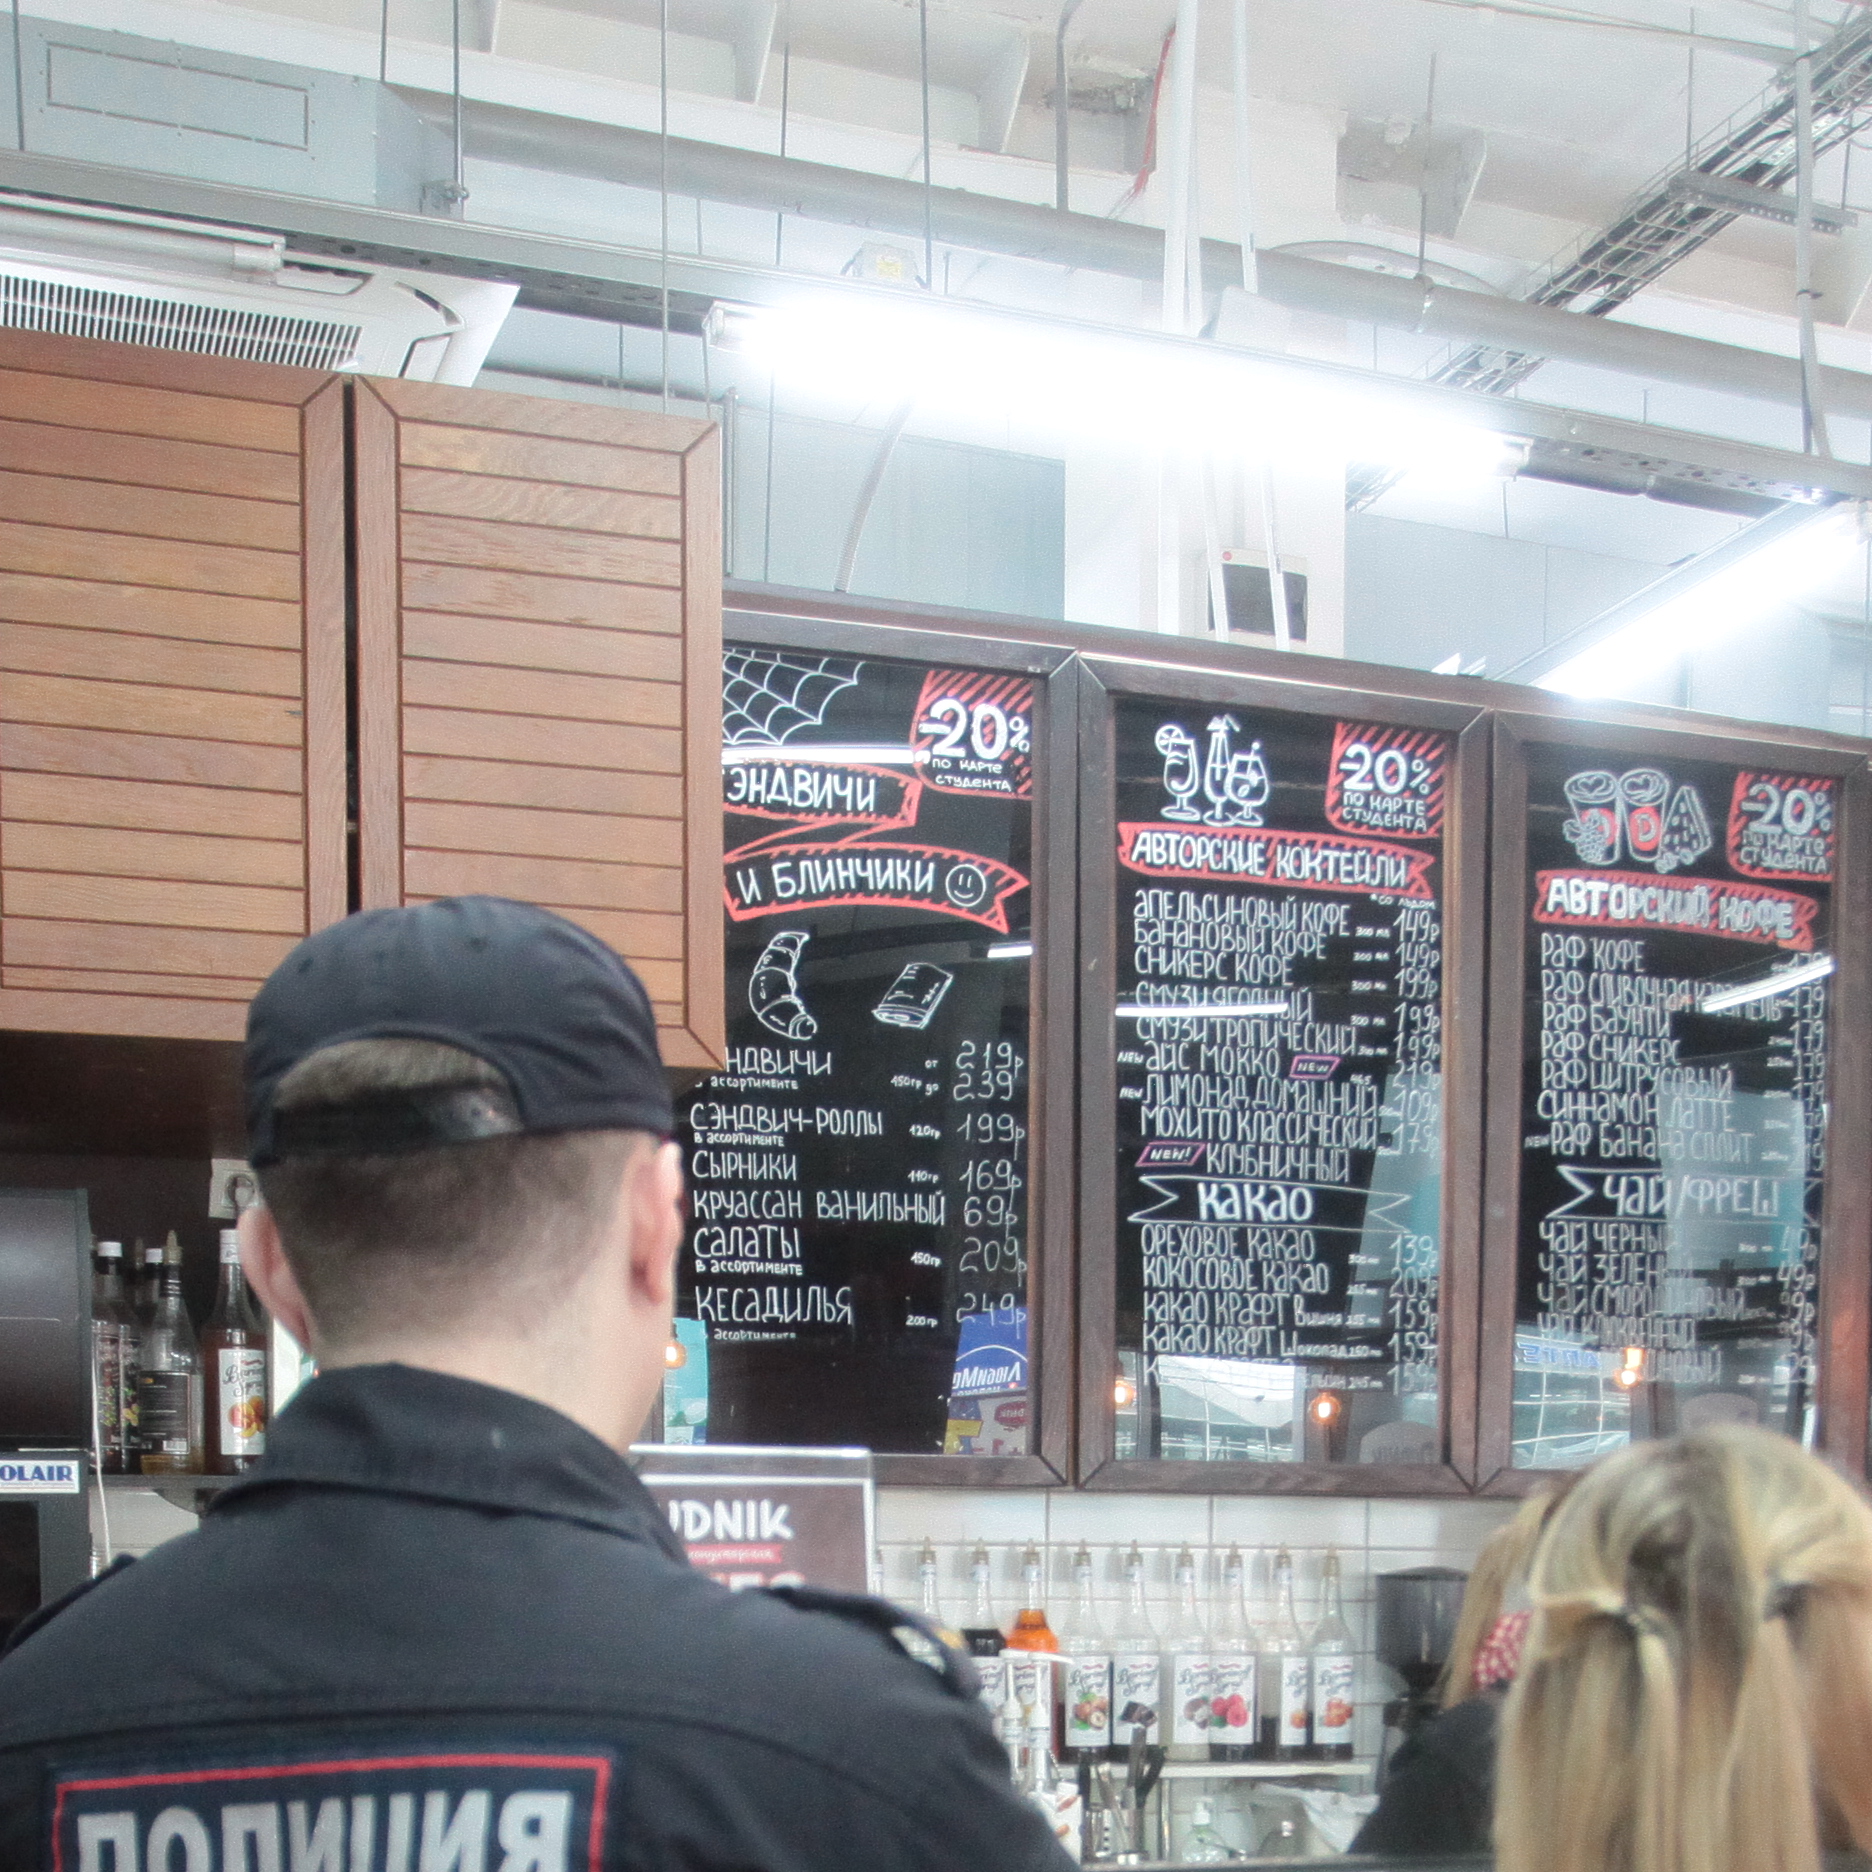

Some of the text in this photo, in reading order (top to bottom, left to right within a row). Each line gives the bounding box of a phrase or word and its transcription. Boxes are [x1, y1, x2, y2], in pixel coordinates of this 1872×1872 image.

[918, 697, 1030, 760] -20%
[1340, 743, 1430, 795] -20%
[723, 768, 875, 812] ЭНДВИЧИ
[1343, 792, 1426, 814] ПО КАРТЕ
[1343, 808, 1428, 831] СТУДЕНТА
[1741, 782, 1832, 837] -20%
[1131, 831, 1407, 887] АВТОРСКИЕ КОКТЕЙЛИ
[736, 859, 935, 904] И БЛИНЧИКИ
[1302, 902, 1350, 936] КОФЕ
[1546, 878, 1794, 939] АВТОРСКИЙ КОФЕ
[1272, 929, 1327, 960] КОФЕ
[1590, 938, 1646, 972] КОФЕ
[1135, 945, 1227, 980] СНИКЕРС
[1235, 953, 1294, 986] КОФЕ
[1136, 1017, 1208, 1043] СМУЗИ
[1210, 1017, 1356, 1056] ТРОПИЧЕСКИЙ
[1589, 1033, 1682, 1067] СНИКЕРС
[1117, 1051, 1144, 1064] NEW
[1200, 1043, 1280, 1077] МОККО
[953, 1070, 1013, 1101] 239
[1119, 1087, 1143, 1099] NEW
[1590, 1061, 1733, 1102] ЦИТРУСОВЫЙ
[690, 1102, 883, 1136] СЭНДВИЧ-РОЛЛЫ
[1141, 1105, 1231, 1140] МОХИТО
[692, 1151, 797, 1181] СЫРНИКИ
[1207, 1141, 1349, 1183] КЛУБНИЧНЫЙ
[1141, 1223, 1240, 1259] ОРЕХОВОЕ
[1143, 1255, 1259, 1292] КОКОСОВОЕ
